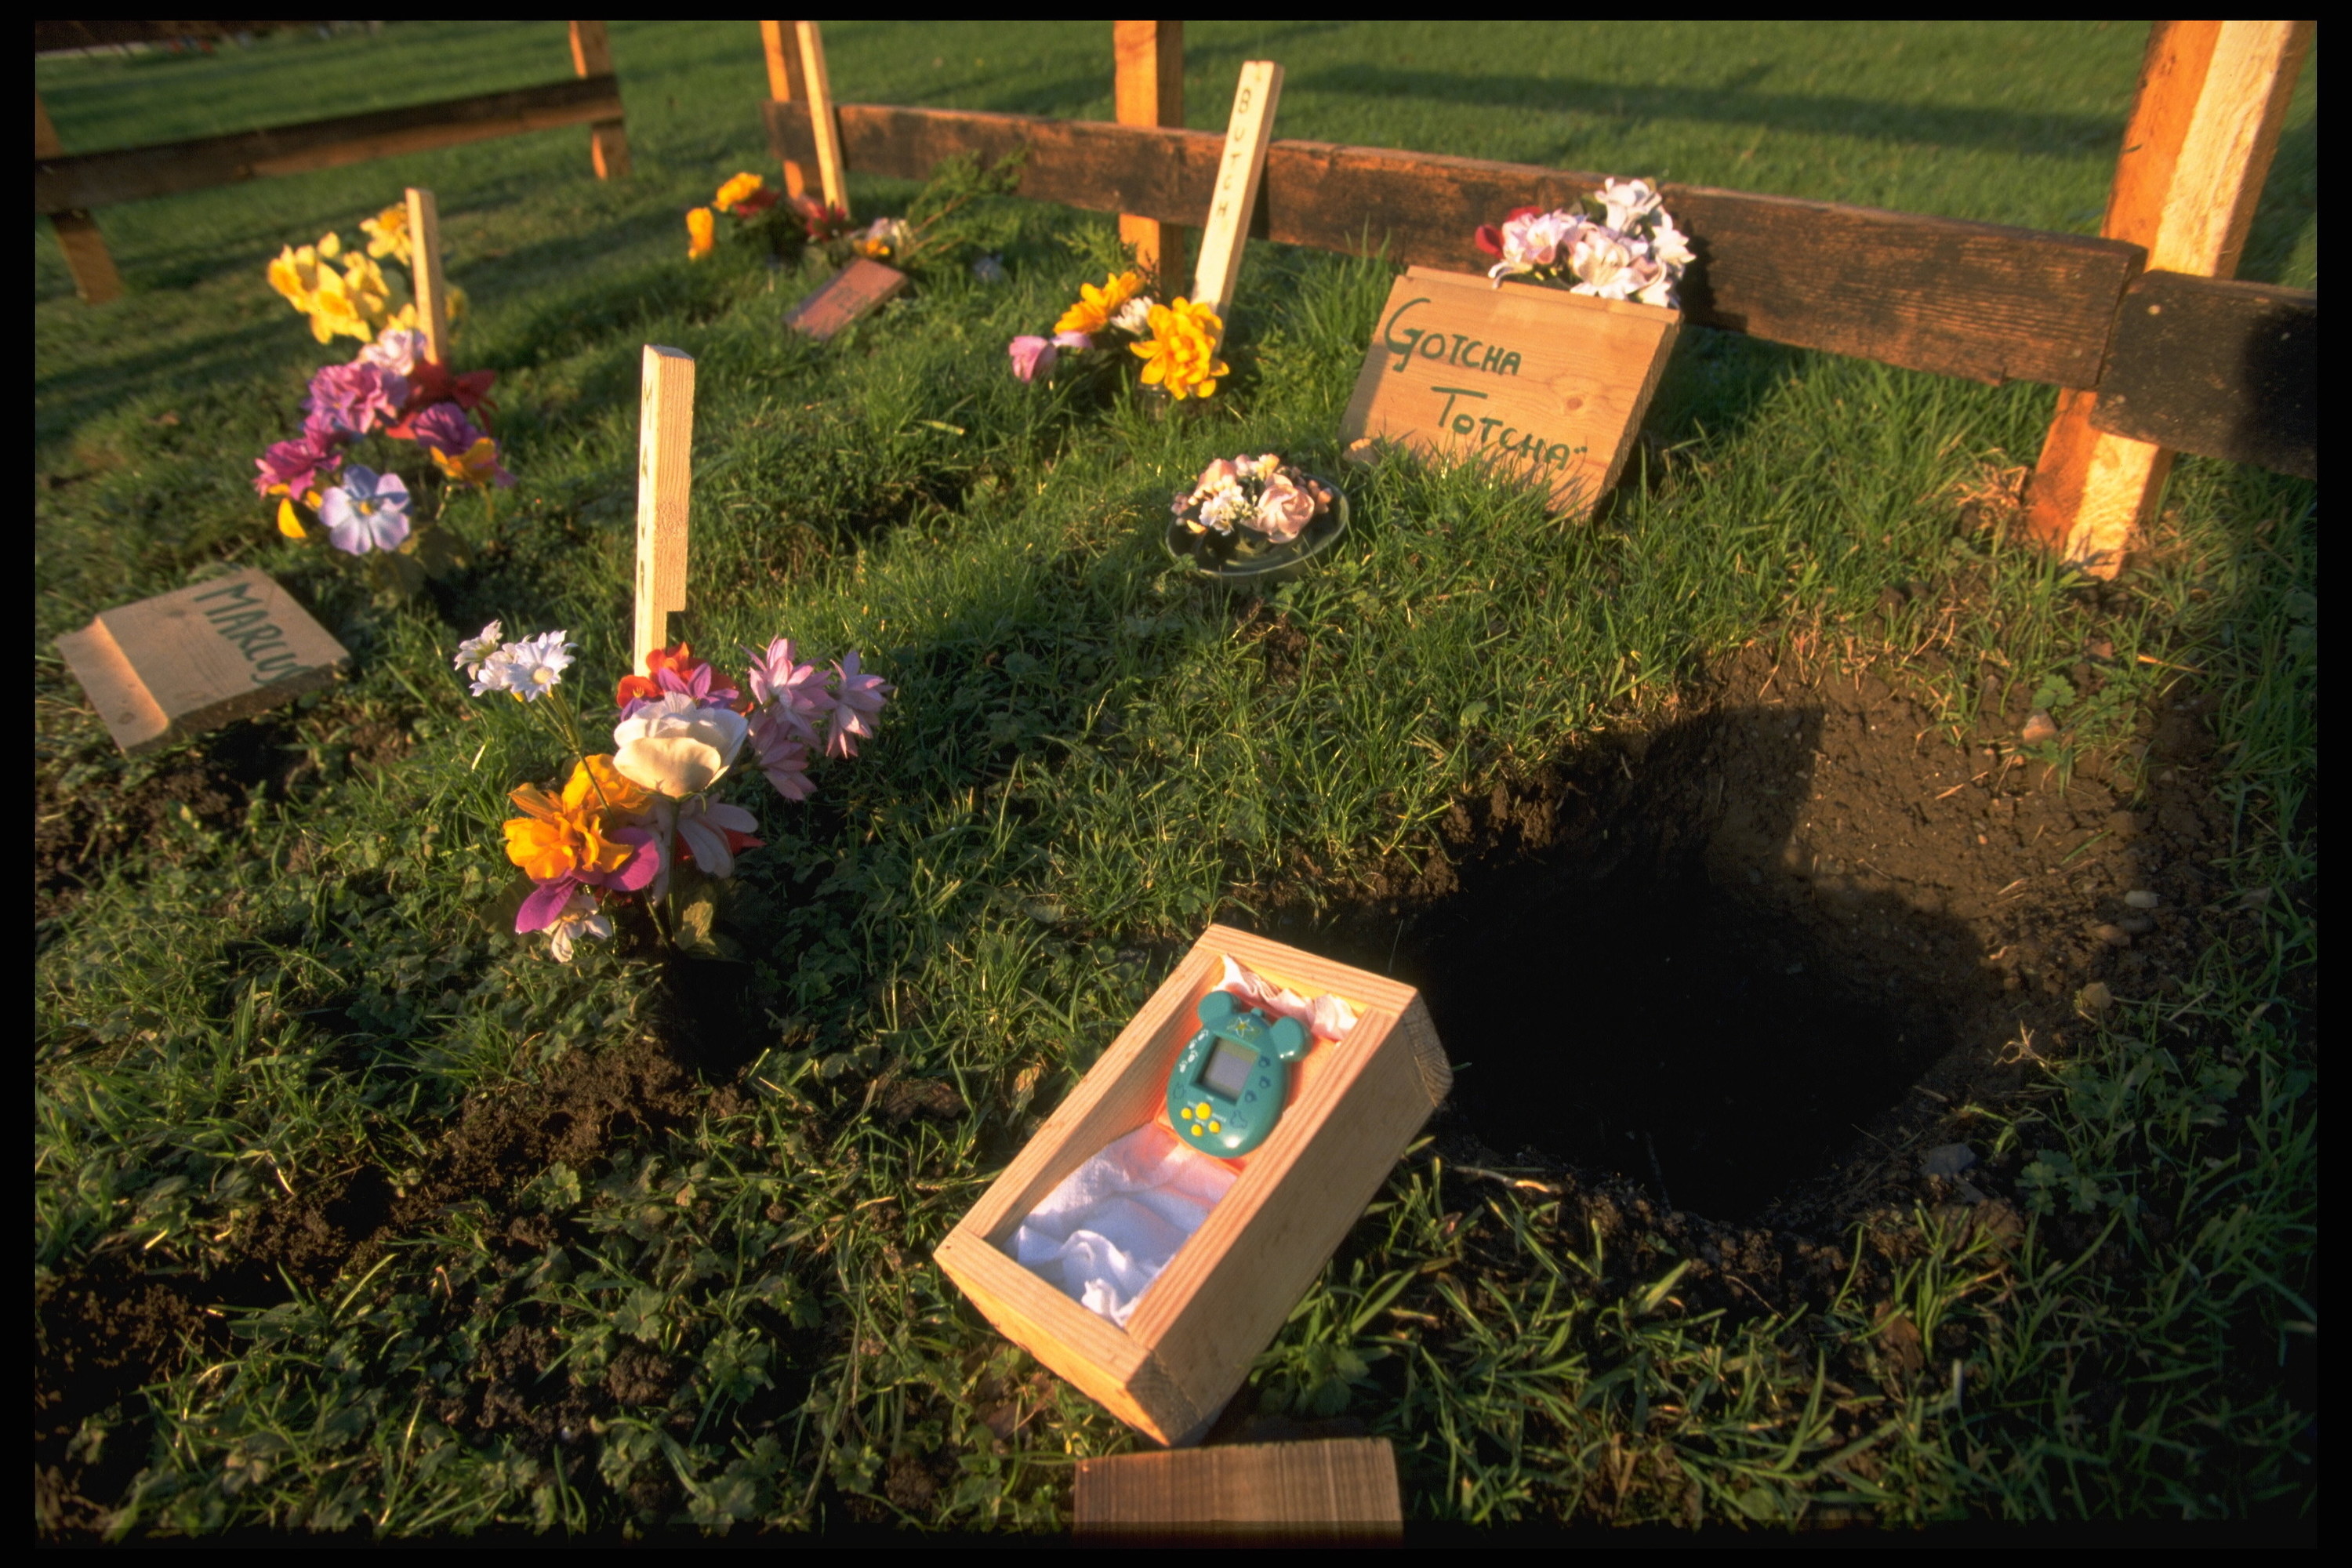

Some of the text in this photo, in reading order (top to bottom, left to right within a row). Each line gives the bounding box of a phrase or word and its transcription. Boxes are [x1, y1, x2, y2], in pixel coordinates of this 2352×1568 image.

[1218, 88, 1250, 217] BUTCH
[1384, 297, 1522, 376] GOTCHA
[193, 583, 316, 685] MARCUS
